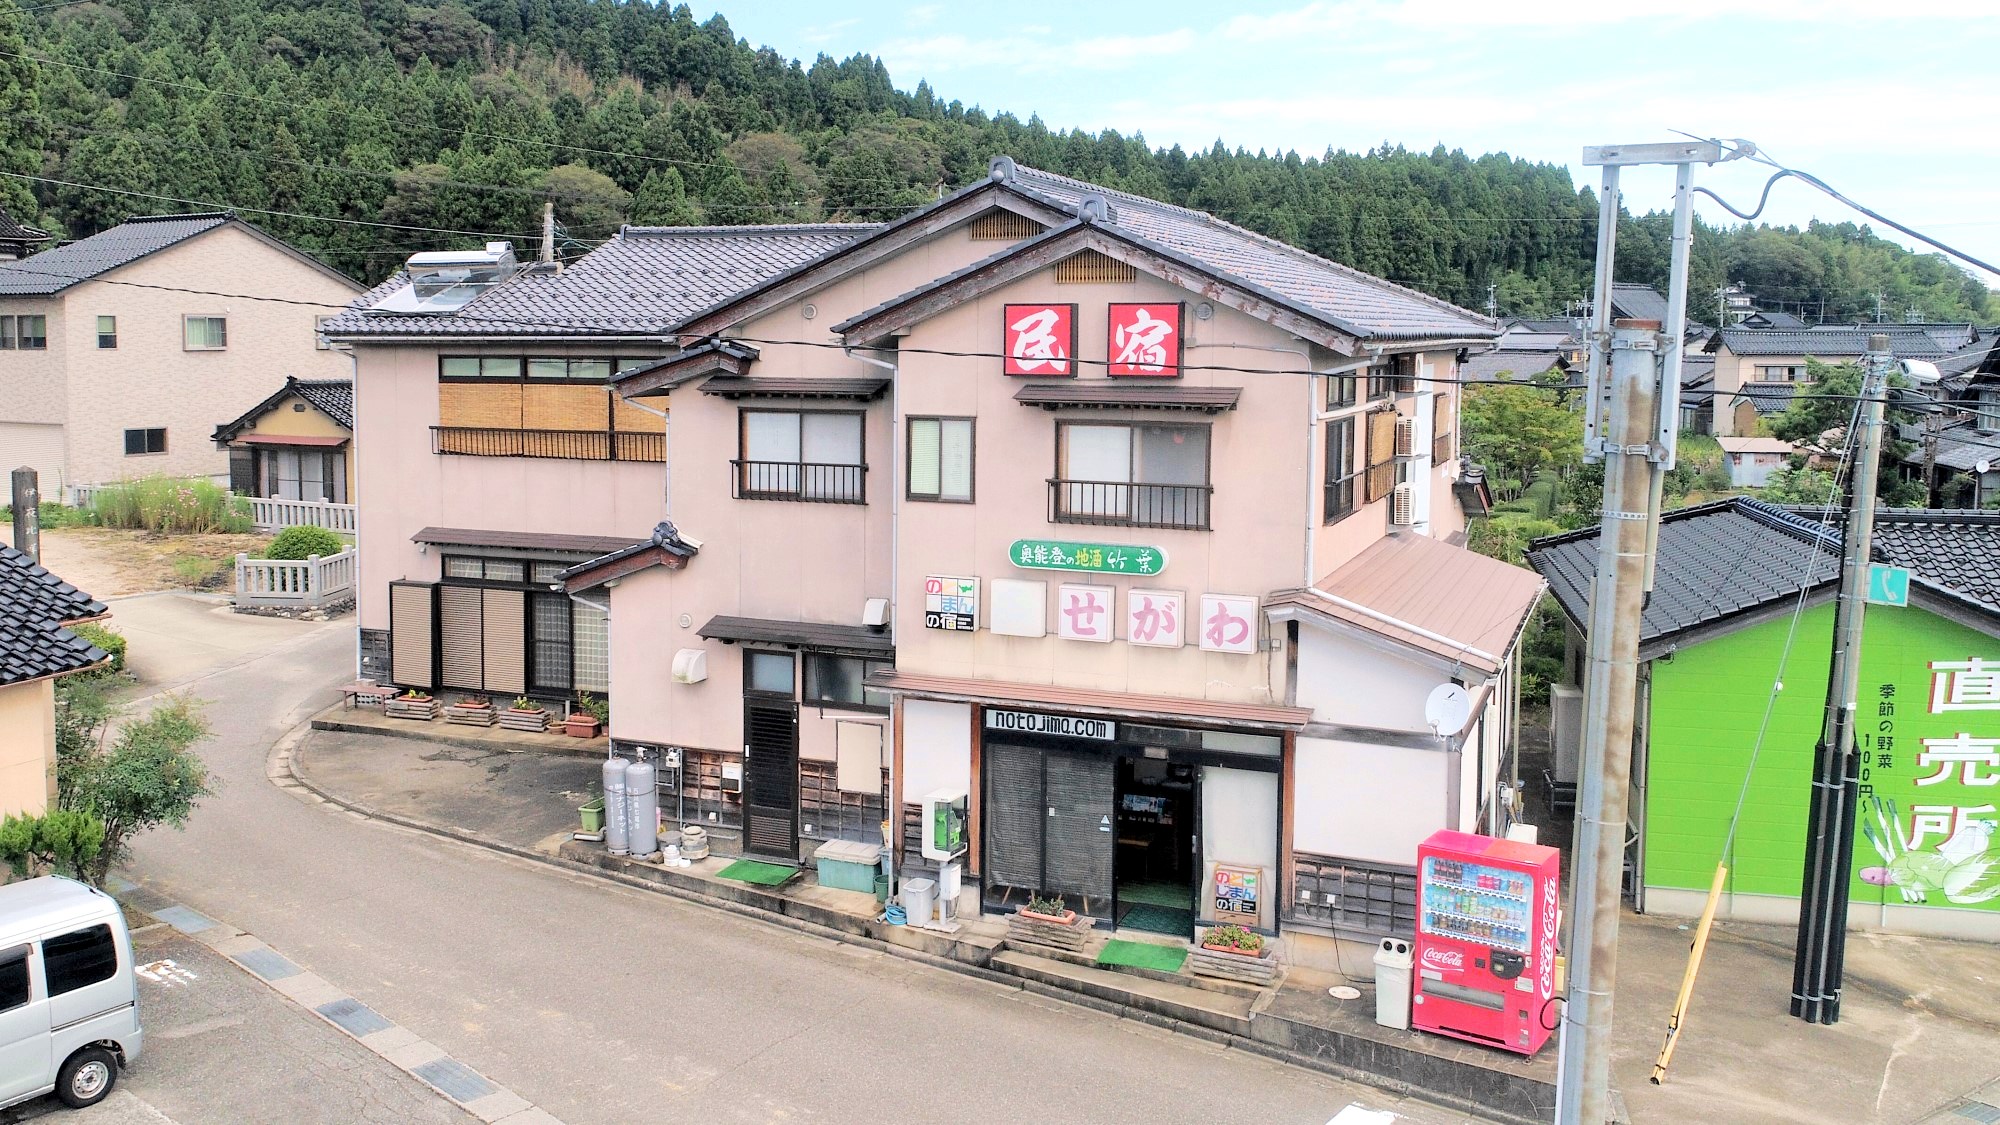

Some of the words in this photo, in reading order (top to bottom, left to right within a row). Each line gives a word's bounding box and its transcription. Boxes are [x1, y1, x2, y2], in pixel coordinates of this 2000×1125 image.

[1010, 308, 1174, 373] 民宿
[926, 613, 958, 630] の宿
[1063, 591, 1249, 648] せがわ
[995, 711, 1107, 738] notojima.com
[1877, 683, 1896, 769] 季節の野菜
[1907, 656, 2000, 851] 直売所
[1423, 947, 1465, 967] Coca-Cola
